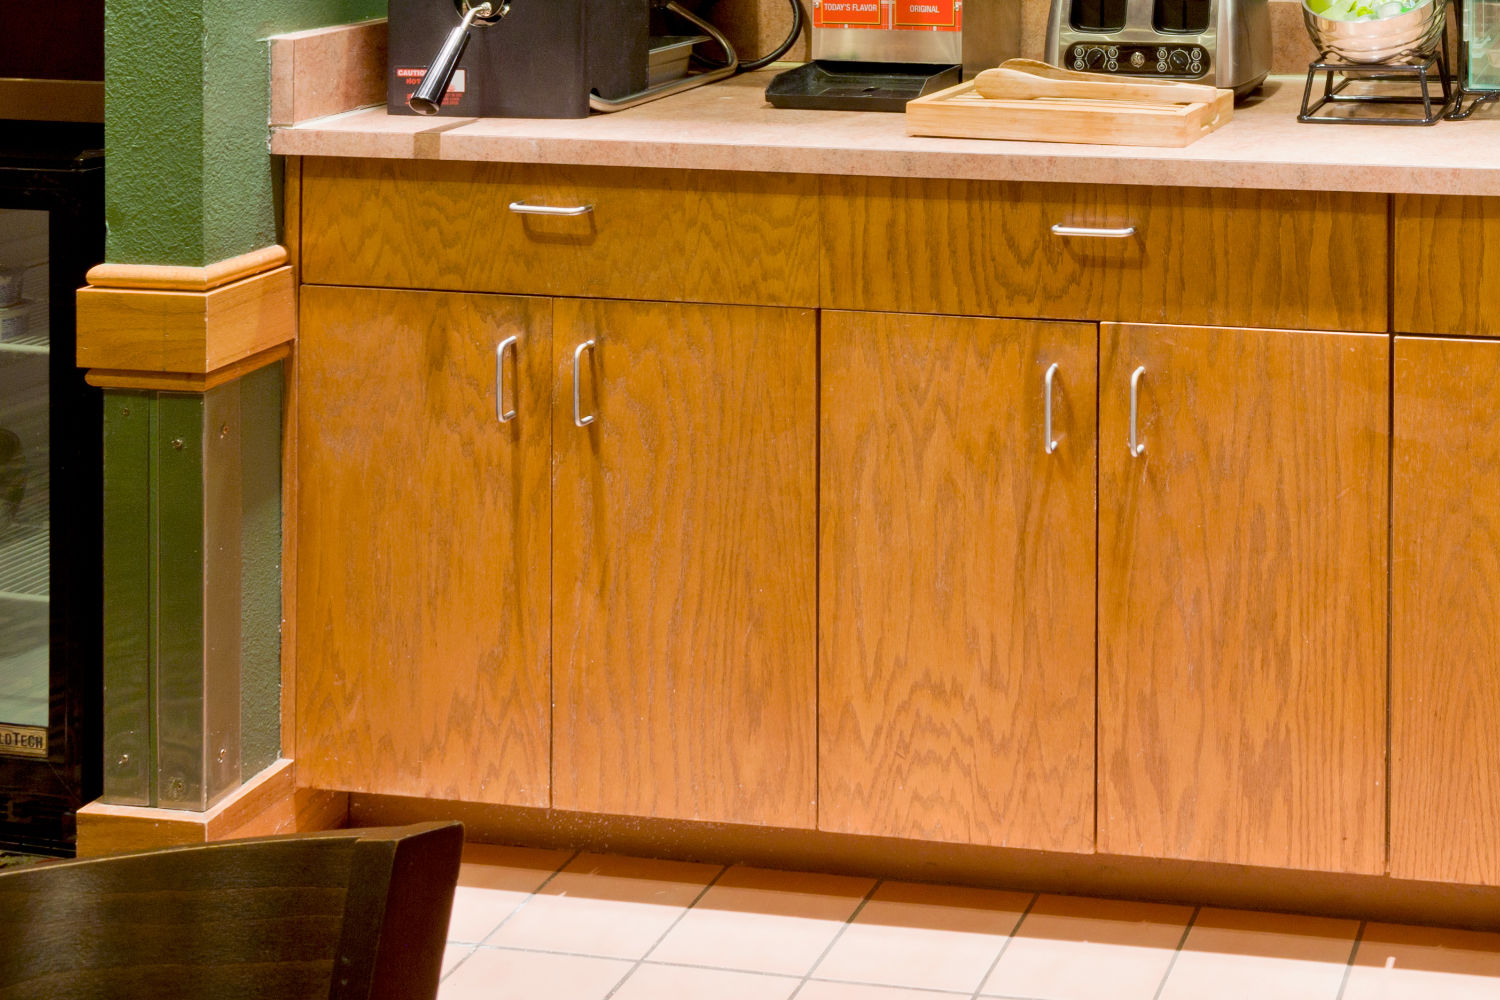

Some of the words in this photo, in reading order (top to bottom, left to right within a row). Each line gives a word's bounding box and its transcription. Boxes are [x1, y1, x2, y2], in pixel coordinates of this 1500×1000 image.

[824, 3, 851, 11] TODAY'S
[852, 3, 877, 12] FLAVOR
[909, 5, 940, 14] ORIGINAL
[397, 69, 428, 77] CAUTIO
